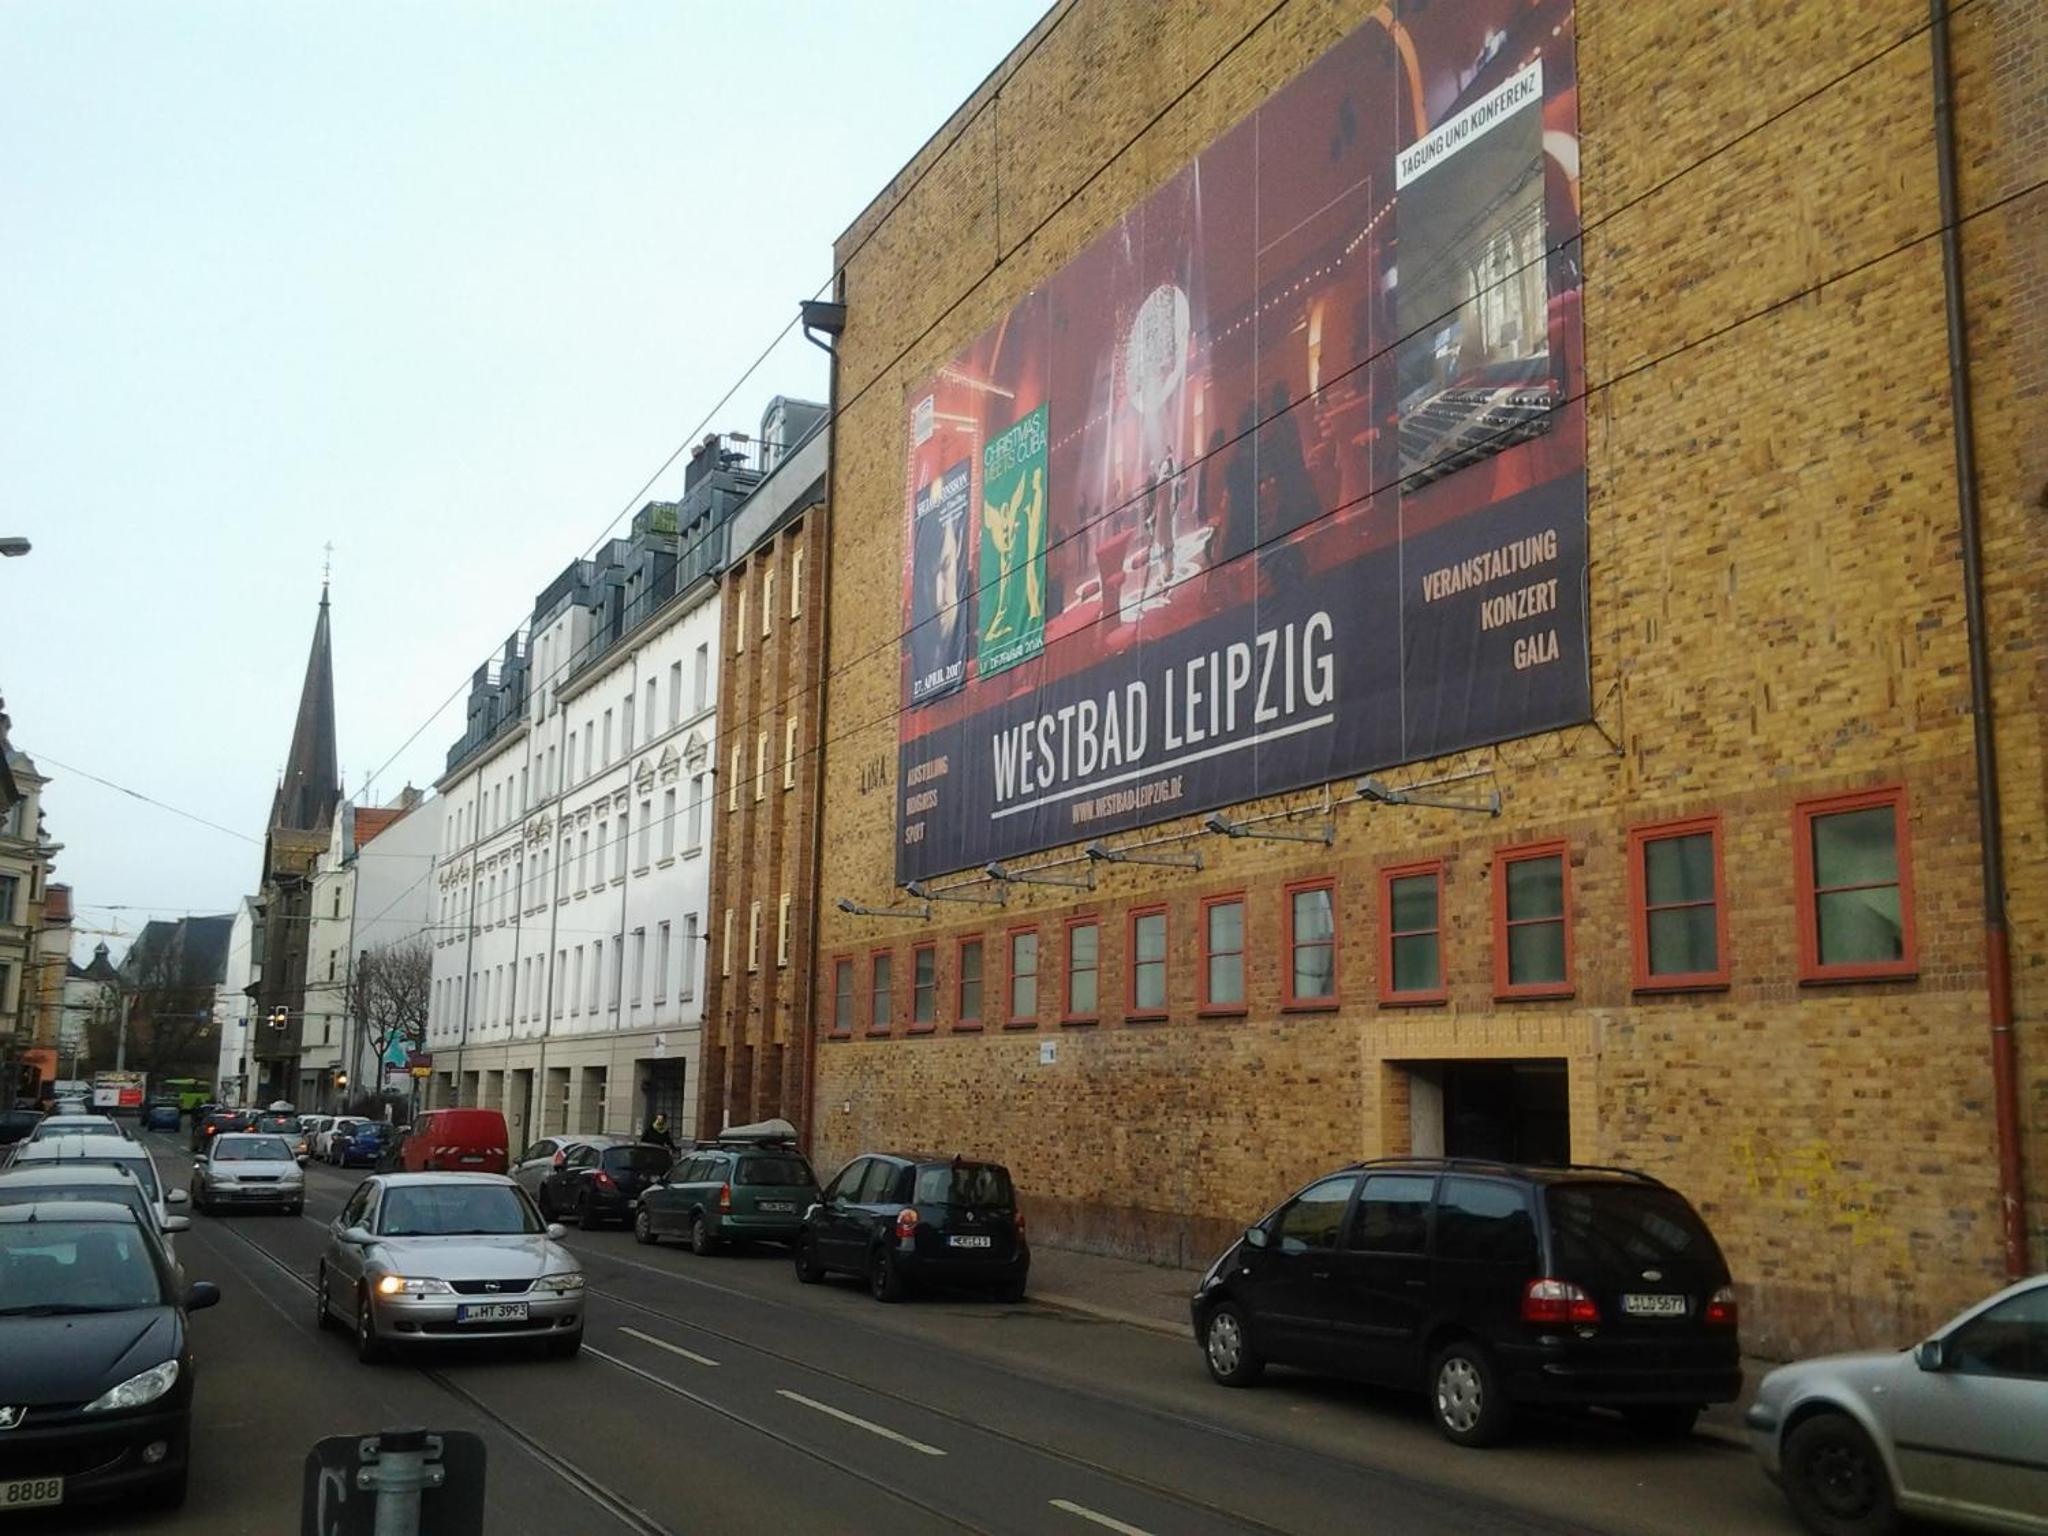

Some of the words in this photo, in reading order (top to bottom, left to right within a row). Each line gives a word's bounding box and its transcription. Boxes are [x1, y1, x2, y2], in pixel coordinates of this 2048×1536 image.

[1402, 135, 1444, 177] TAGUNG
[1445, 118, 1469, 149] UND
[1470, 73, 1536, 132] KONFERENZ
[1423, 529, 1558, 603] VERANSTALTUNG
[1482, 578, 1558, 631] KONZERT
[1514, 629, 1560, 670] GALA
[993, 680, 1148, 803] WESTBAD
[1164, 611, 1335, 751] LEIPZIG
[7, 1480, 60, 1502] 8888
